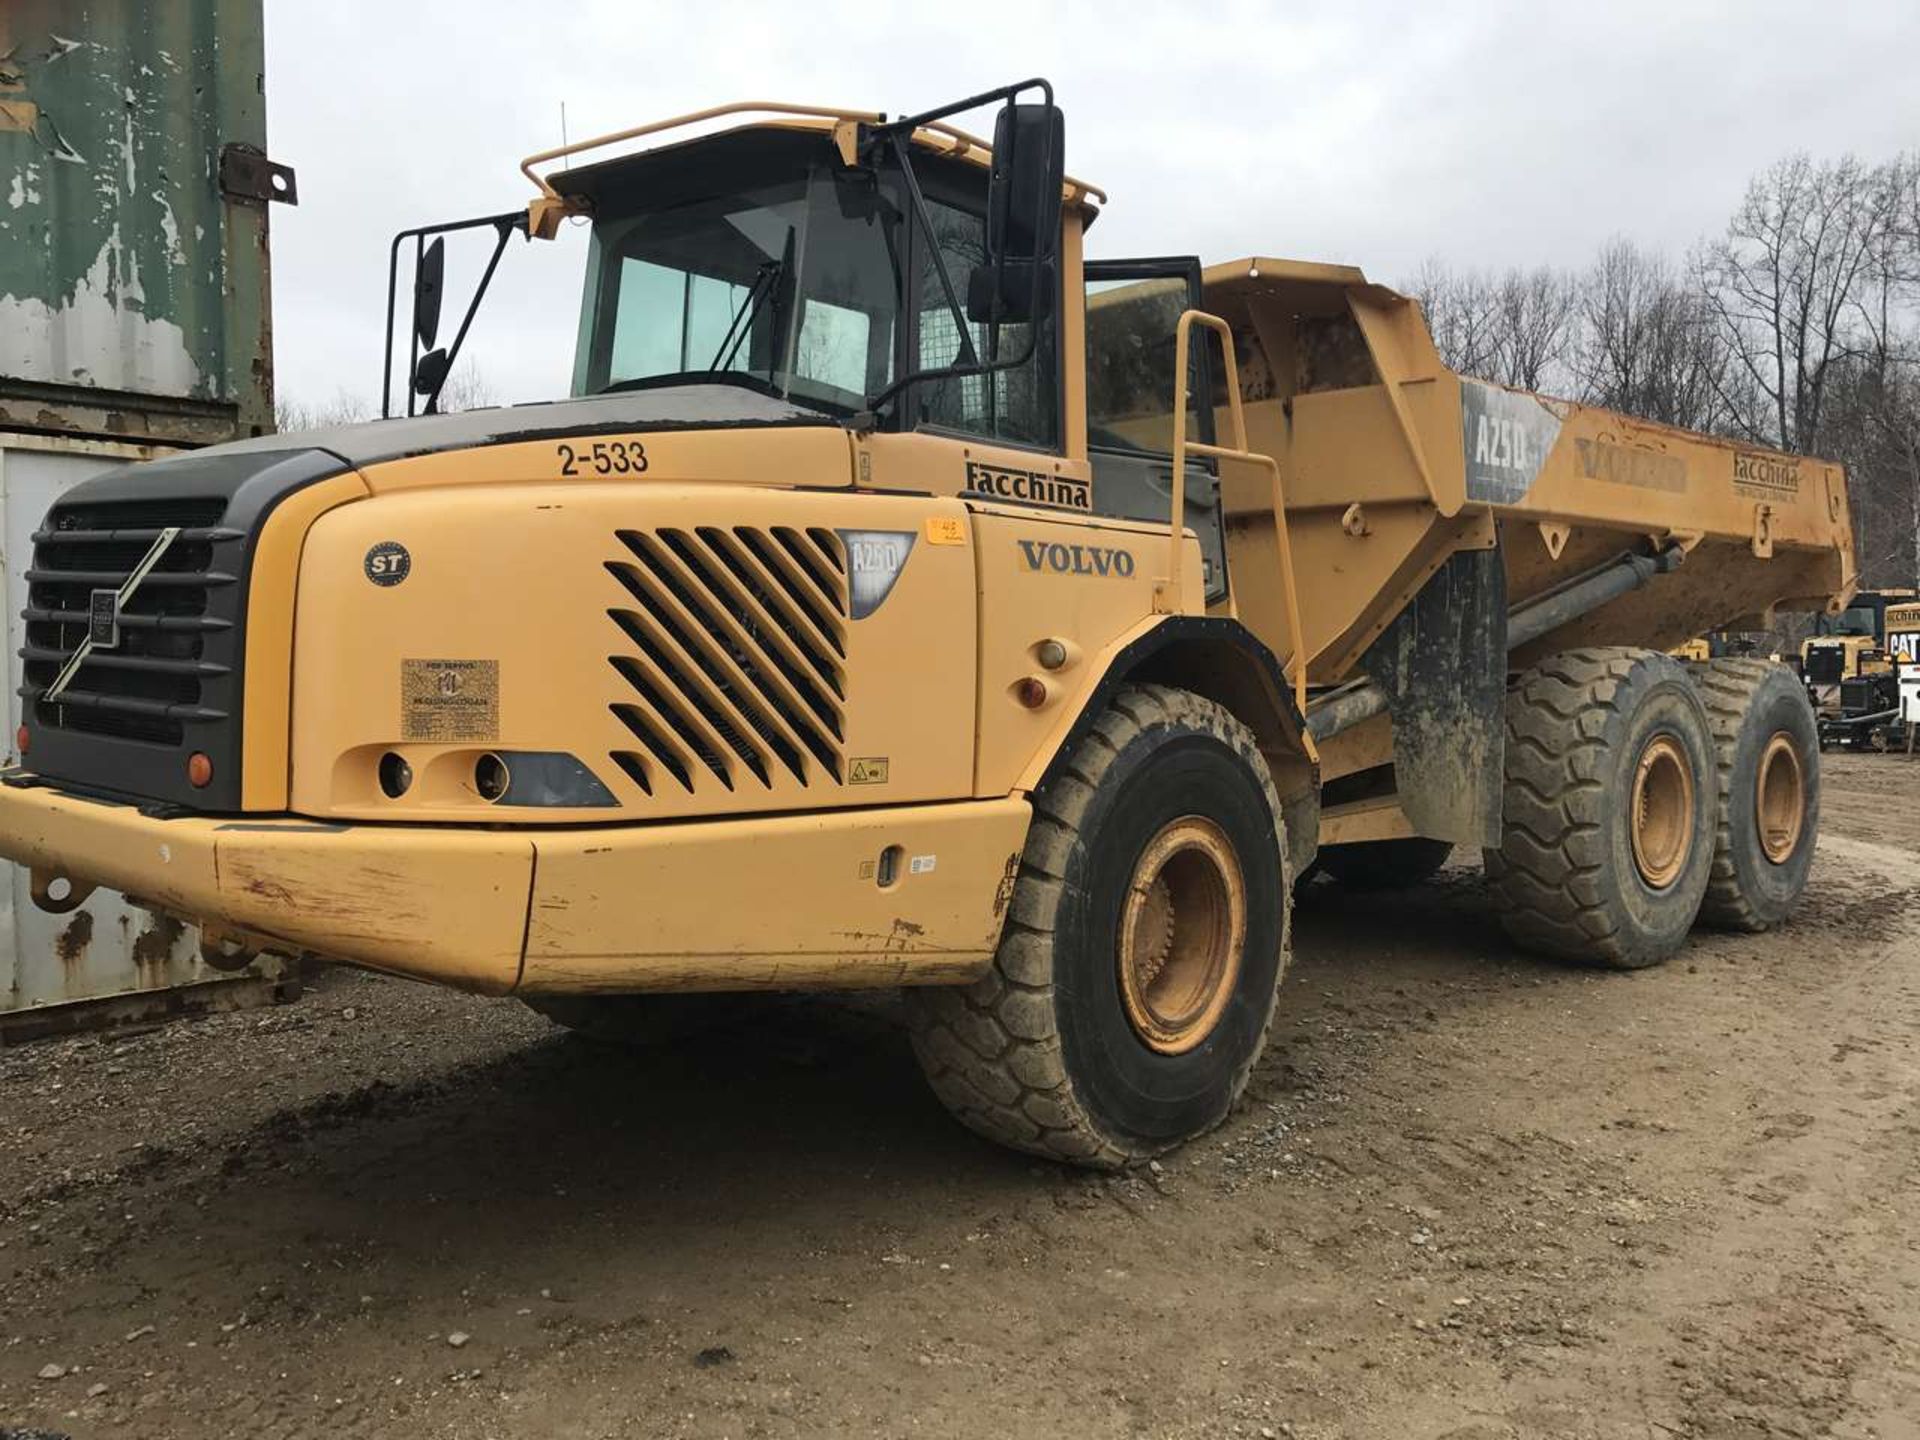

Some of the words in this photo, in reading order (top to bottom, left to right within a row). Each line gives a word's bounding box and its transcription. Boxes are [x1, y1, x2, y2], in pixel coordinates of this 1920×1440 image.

[557, 442, 648, 476] 2-533
[966, 461, 1089, 508] Facchina
[371, 555, 403, 573] ST
[1017, 540, 1135, 578] VOLVO
[1890, 633, 1919, 662] CAT
